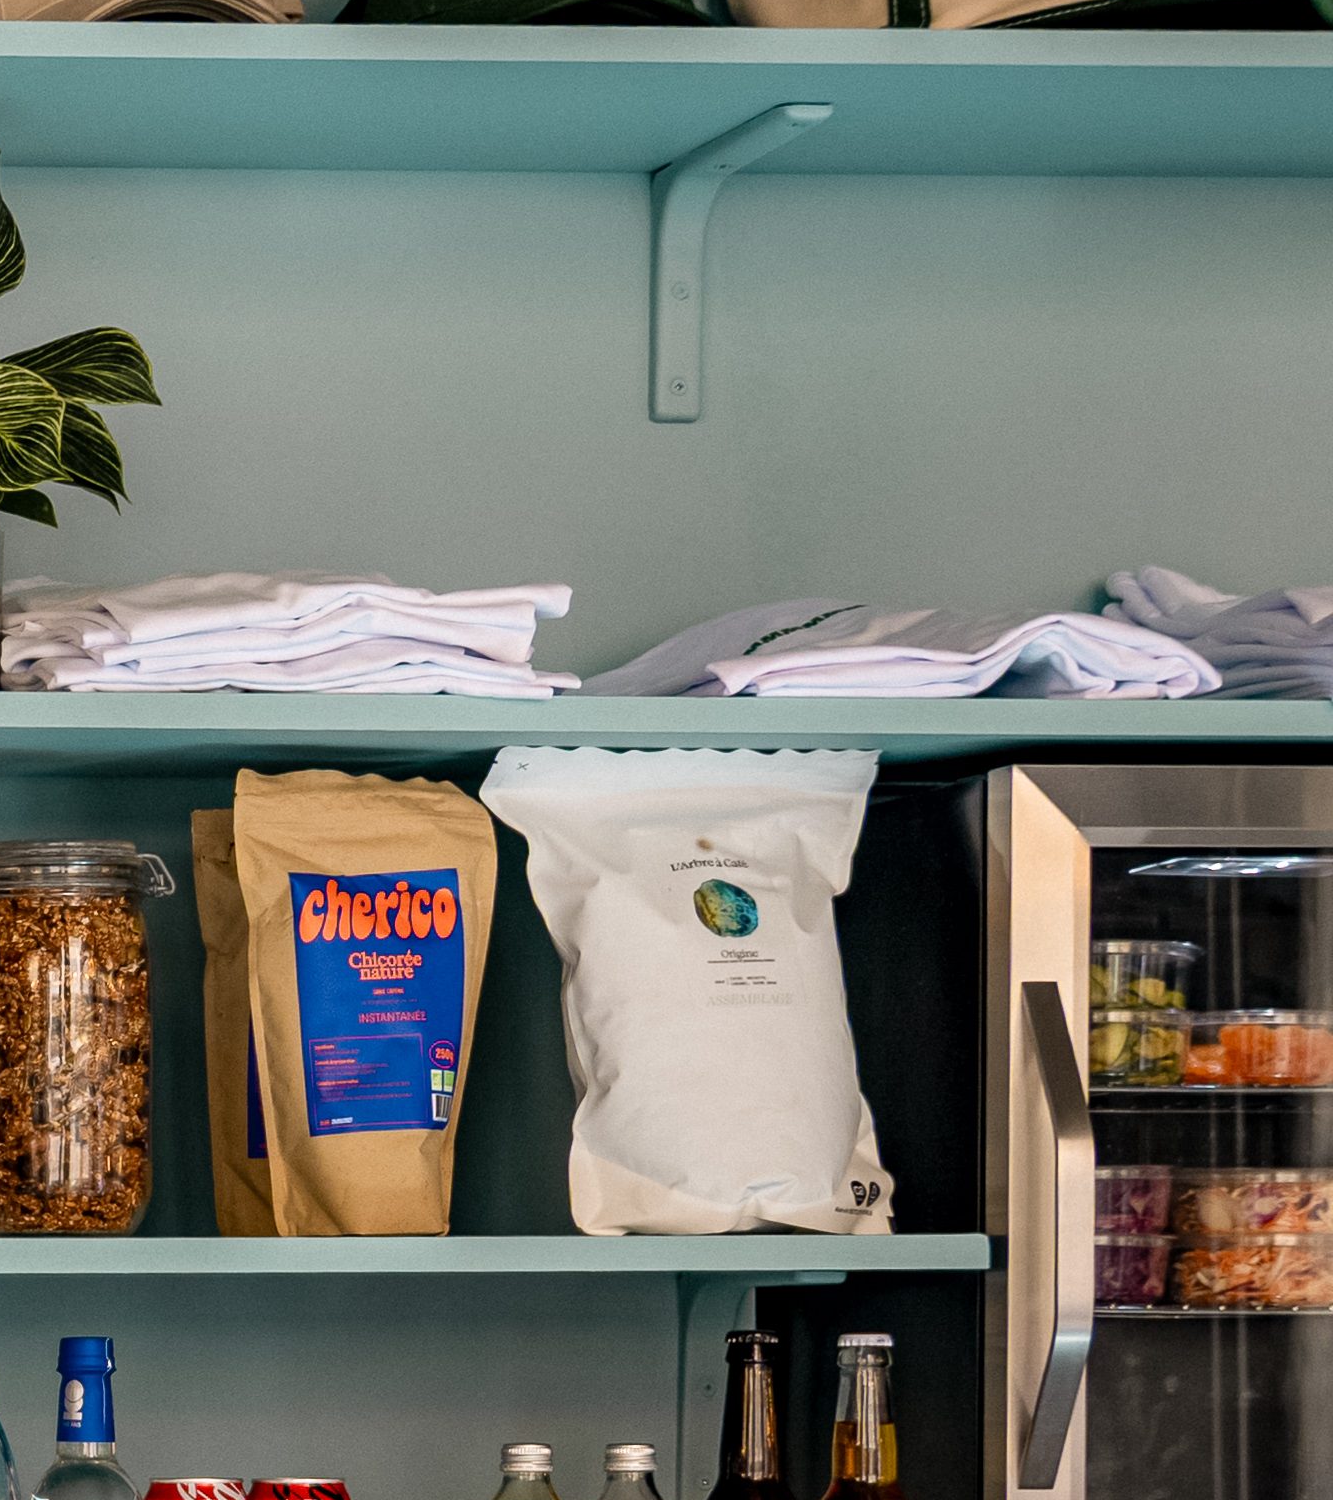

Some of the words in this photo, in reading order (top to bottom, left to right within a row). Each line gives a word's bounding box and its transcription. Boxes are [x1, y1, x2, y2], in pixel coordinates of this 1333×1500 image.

[298, 879, 458, 943] cherico
[348, 949, 422, 969] Chicorée
[721, 949, 758, 959] Origine
[359, 965, 414, 981] nature
[358, 1010, 426, 1024] INSTANTANÉE
